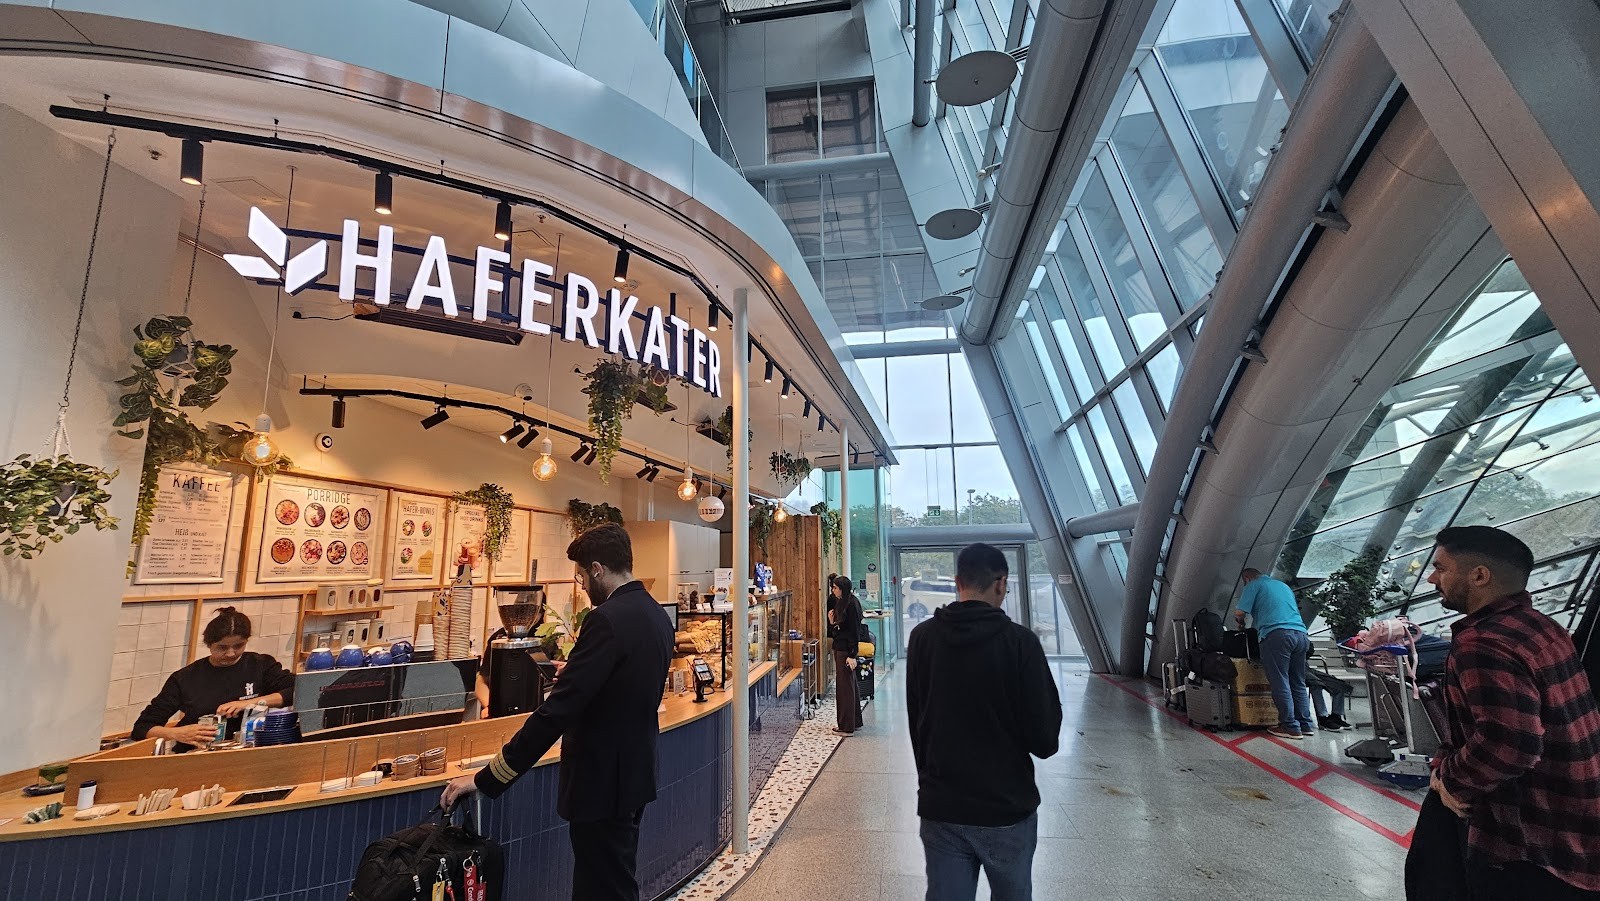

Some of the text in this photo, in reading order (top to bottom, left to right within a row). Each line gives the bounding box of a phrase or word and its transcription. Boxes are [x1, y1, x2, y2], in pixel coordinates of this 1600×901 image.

[339, 219, 722, 398] HAFERKATER
[173, 473, 221, 492] KAFFEE
[307, 488, 351, 504] PORRIDGE
